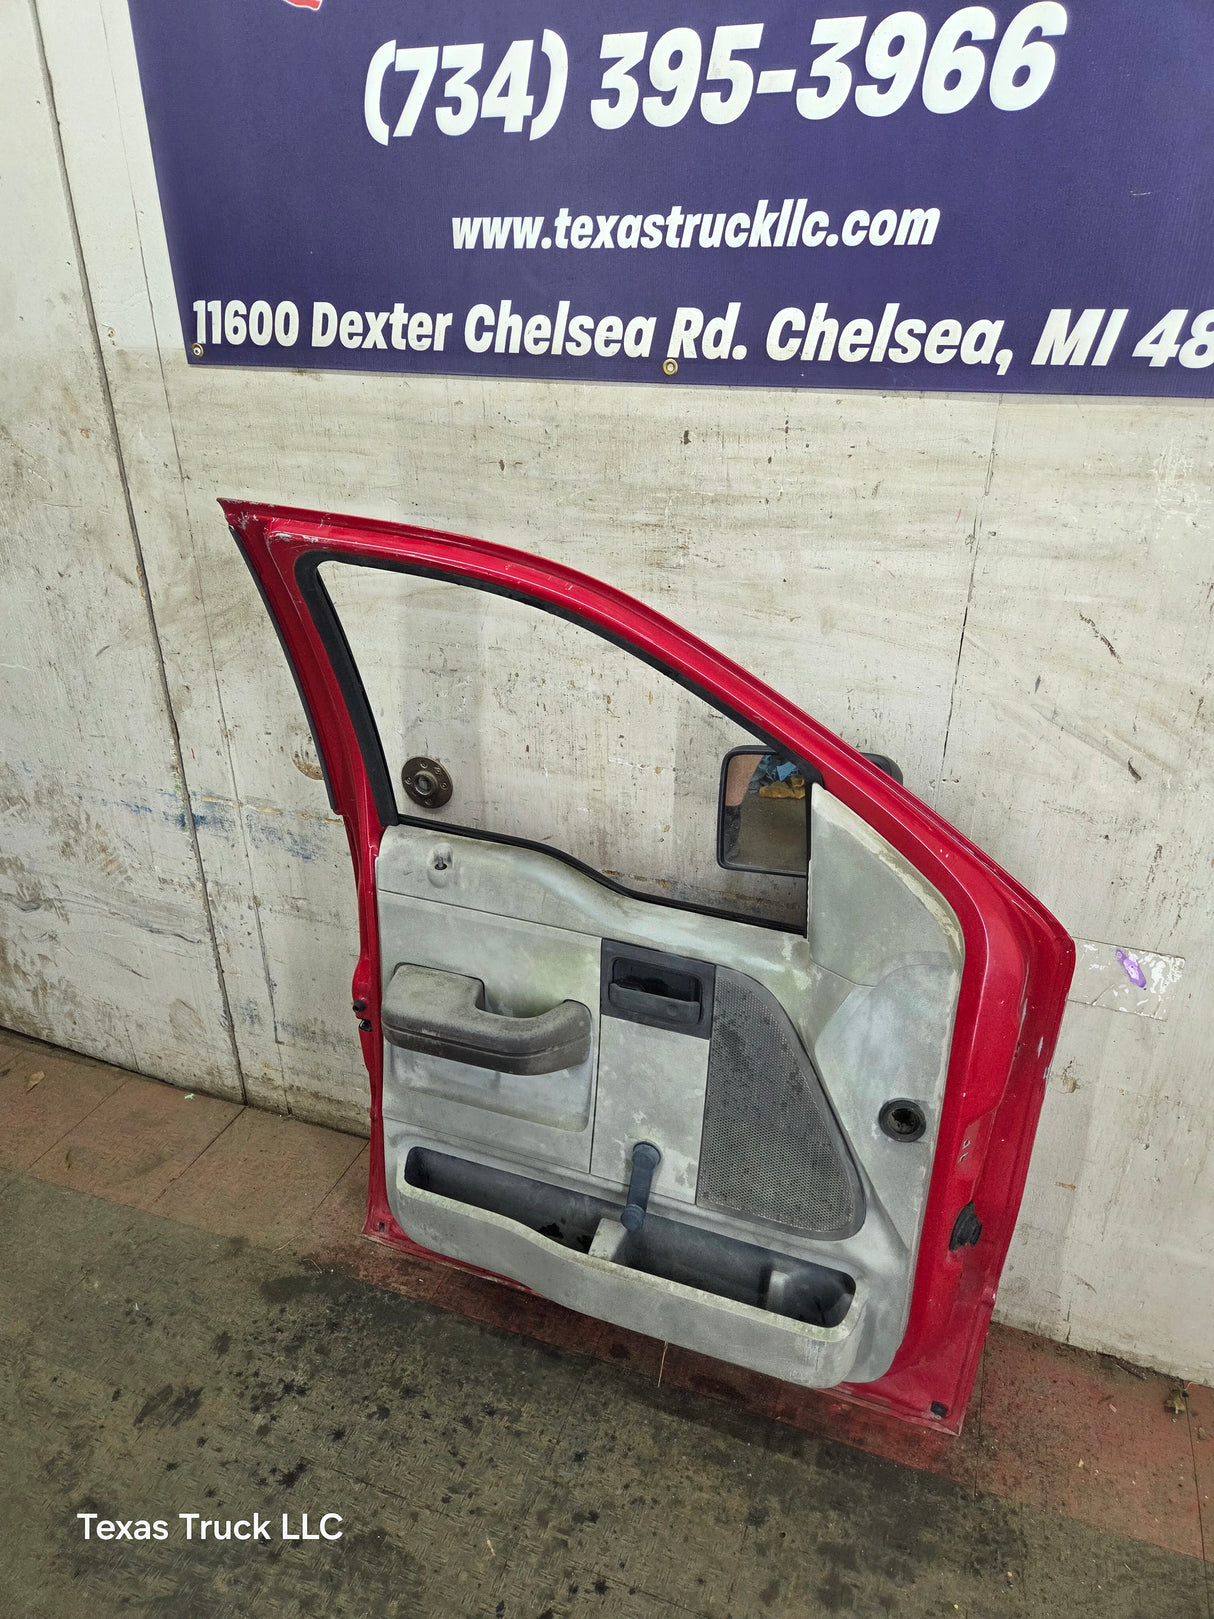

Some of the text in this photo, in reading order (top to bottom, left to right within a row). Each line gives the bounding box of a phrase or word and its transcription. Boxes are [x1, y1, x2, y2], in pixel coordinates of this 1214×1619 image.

[365, 1, 1067, 145] (734) 395-3966
[452, 199, 940, 249] www.texastruckllc.com
[193, 300, 299, 347] 11600
[312, 302, 453, 351] Dexter
[465, 300, 657, 357] Chelsea
[667, 302, 747, 360] Rd.
[766, 303, 1013, 375] Chelsea,
[1031, 309, 1129, 366] MI
